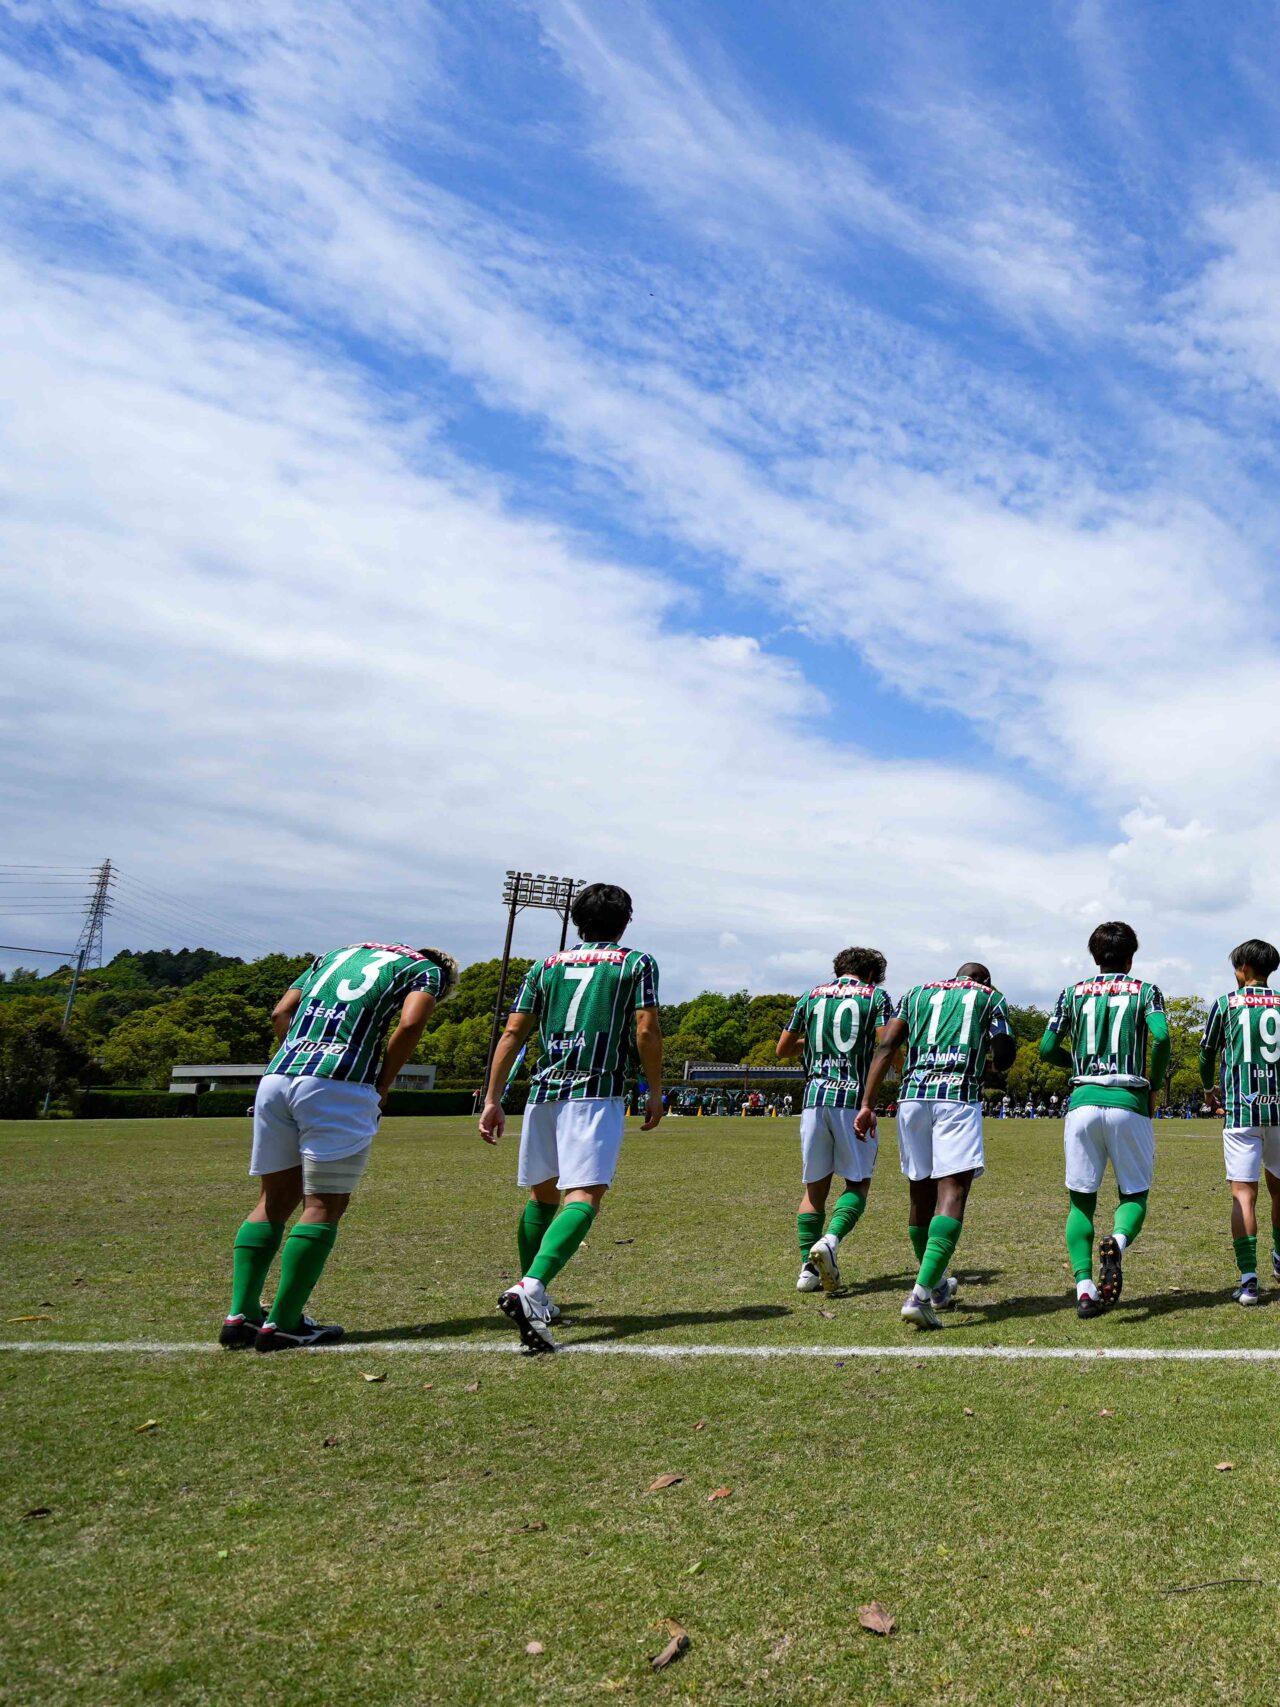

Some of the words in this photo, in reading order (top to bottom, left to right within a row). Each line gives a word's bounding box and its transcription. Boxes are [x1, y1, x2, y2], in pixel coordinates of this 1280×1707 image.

[546, 950, 622, 965] FRONTIER
[308, 947, 403, 1001] 13
[926, 980, 992, 992] FRONTIER
[563, 967, 595, 1032] 7
[304, 1006, 346, 1021] SERA
[928, 990, 978, 1045] 11
[813, 998, 860, 1053] 10
[1082, 995, 1130, 1055] 17
[814, 1058, 852, 1068] KANTA
[919, 1052, 967, 1063] LAMINE
[1253, 1069, 1273, 1078] IBU
